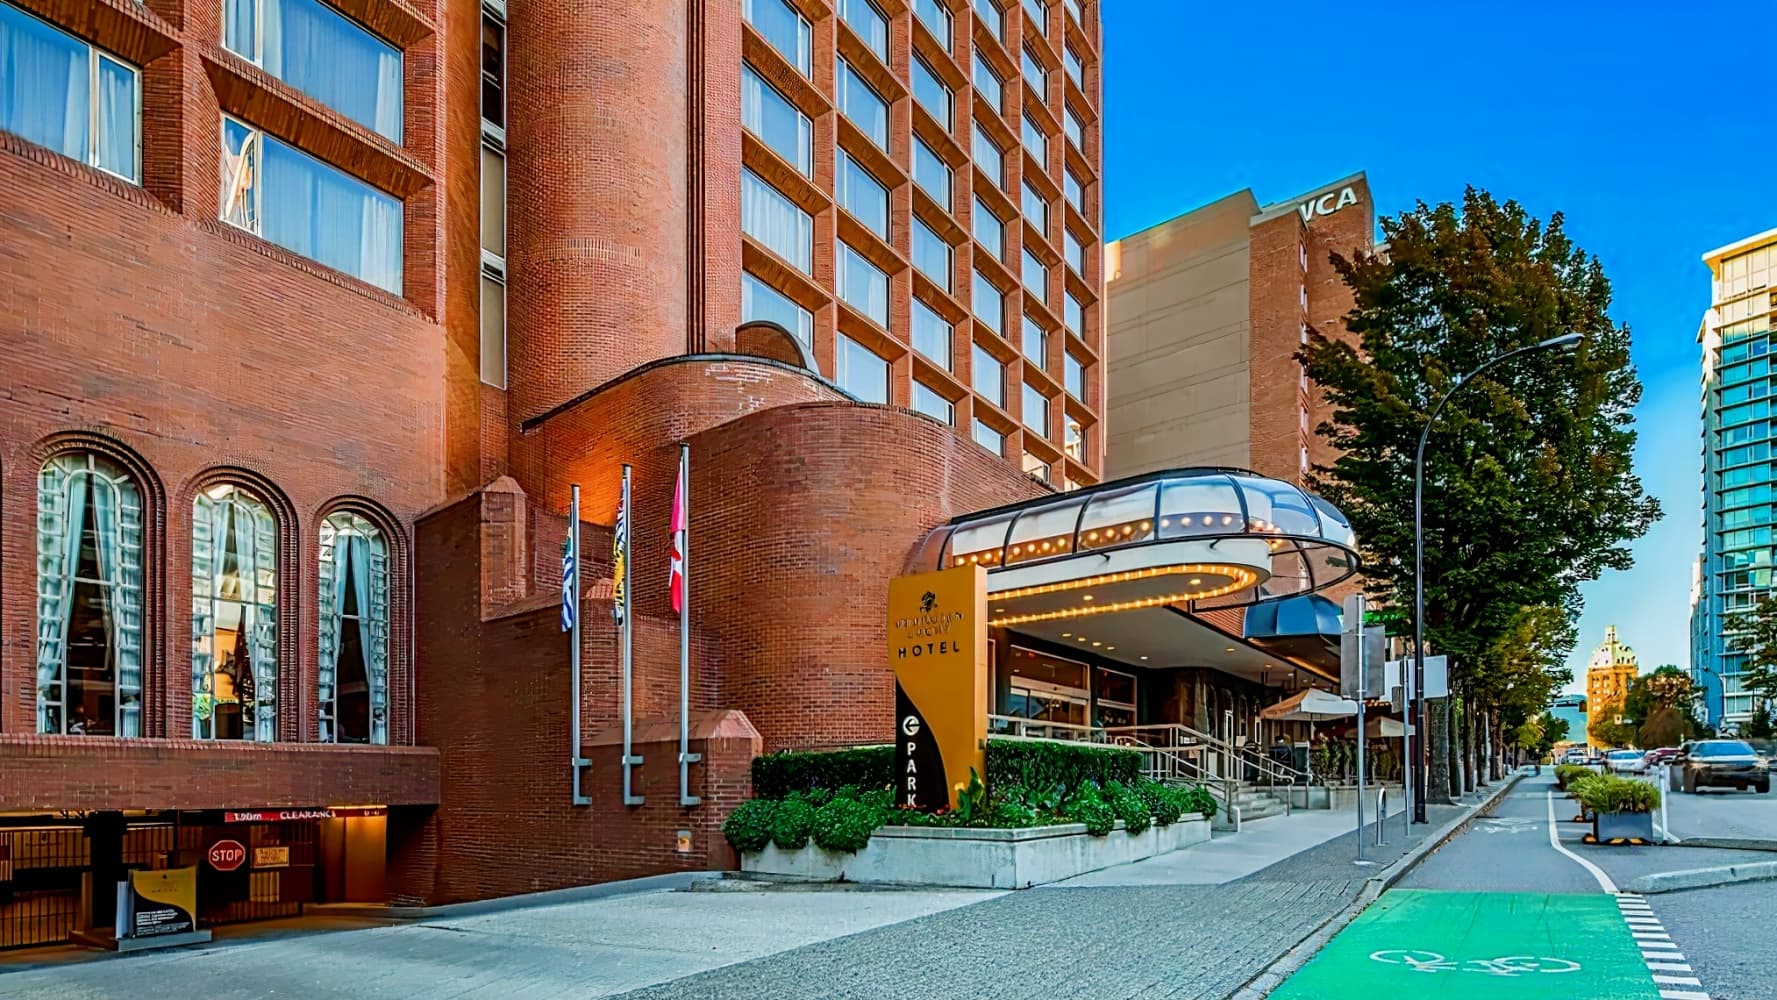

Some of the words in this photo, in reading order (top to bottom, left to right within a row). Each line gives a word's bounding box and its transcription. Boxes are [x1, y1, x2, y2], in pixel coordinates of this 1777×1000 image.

[898, 640, 960, 659] HOTEL
[906, 742, 917, 808] PARK
[212, 849, 243, 862] STOP
